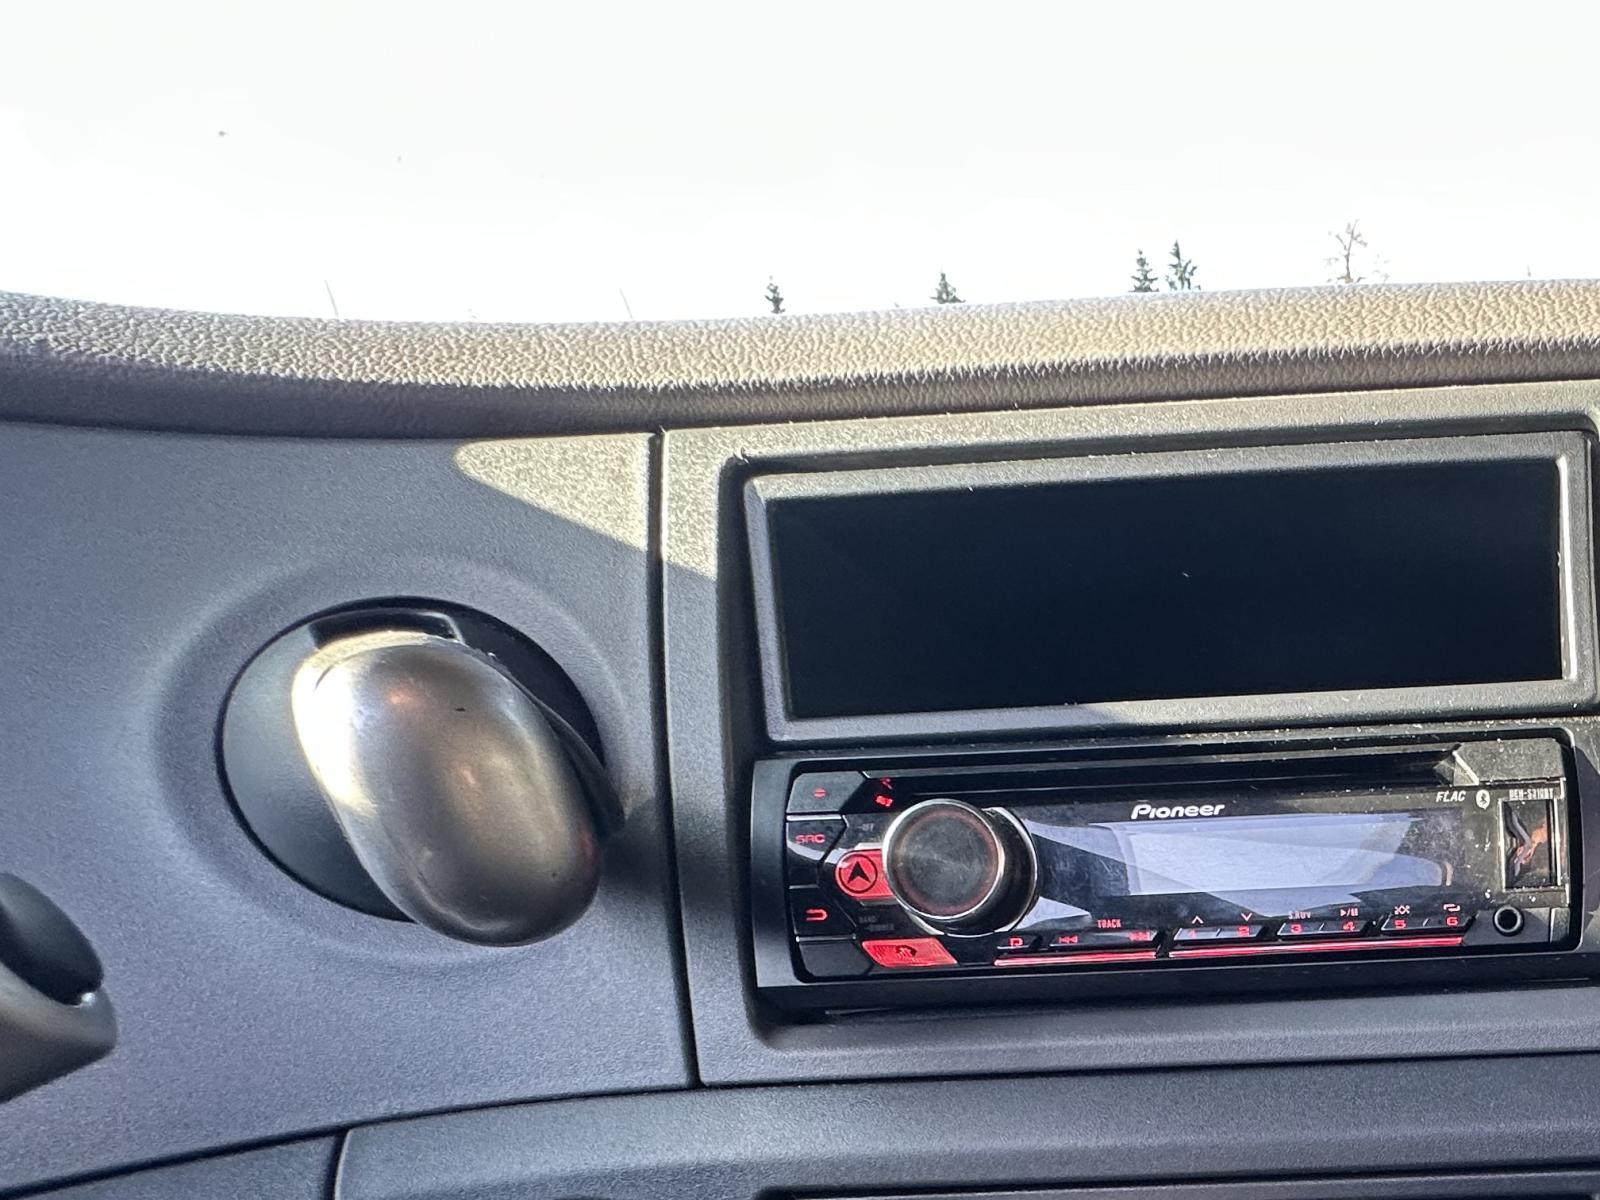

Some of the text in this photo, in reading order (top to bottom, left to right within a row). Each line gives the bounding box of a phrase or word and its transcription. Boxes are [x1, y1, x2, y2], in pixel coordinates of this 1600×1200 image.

[1436, 789, 1467, 803] FLAC
[1130, 803, 1226, 820] Pioneer
[795, 833, 826, 844] SRC
[1096, 919, 1122, 929] TRACK
[1290, 923, 1302, 934] 3
[1342, 921, 1355, 932] 4
[1394, 919, 1407, 929] 5
[1446, 916, 1459, 927] 6
